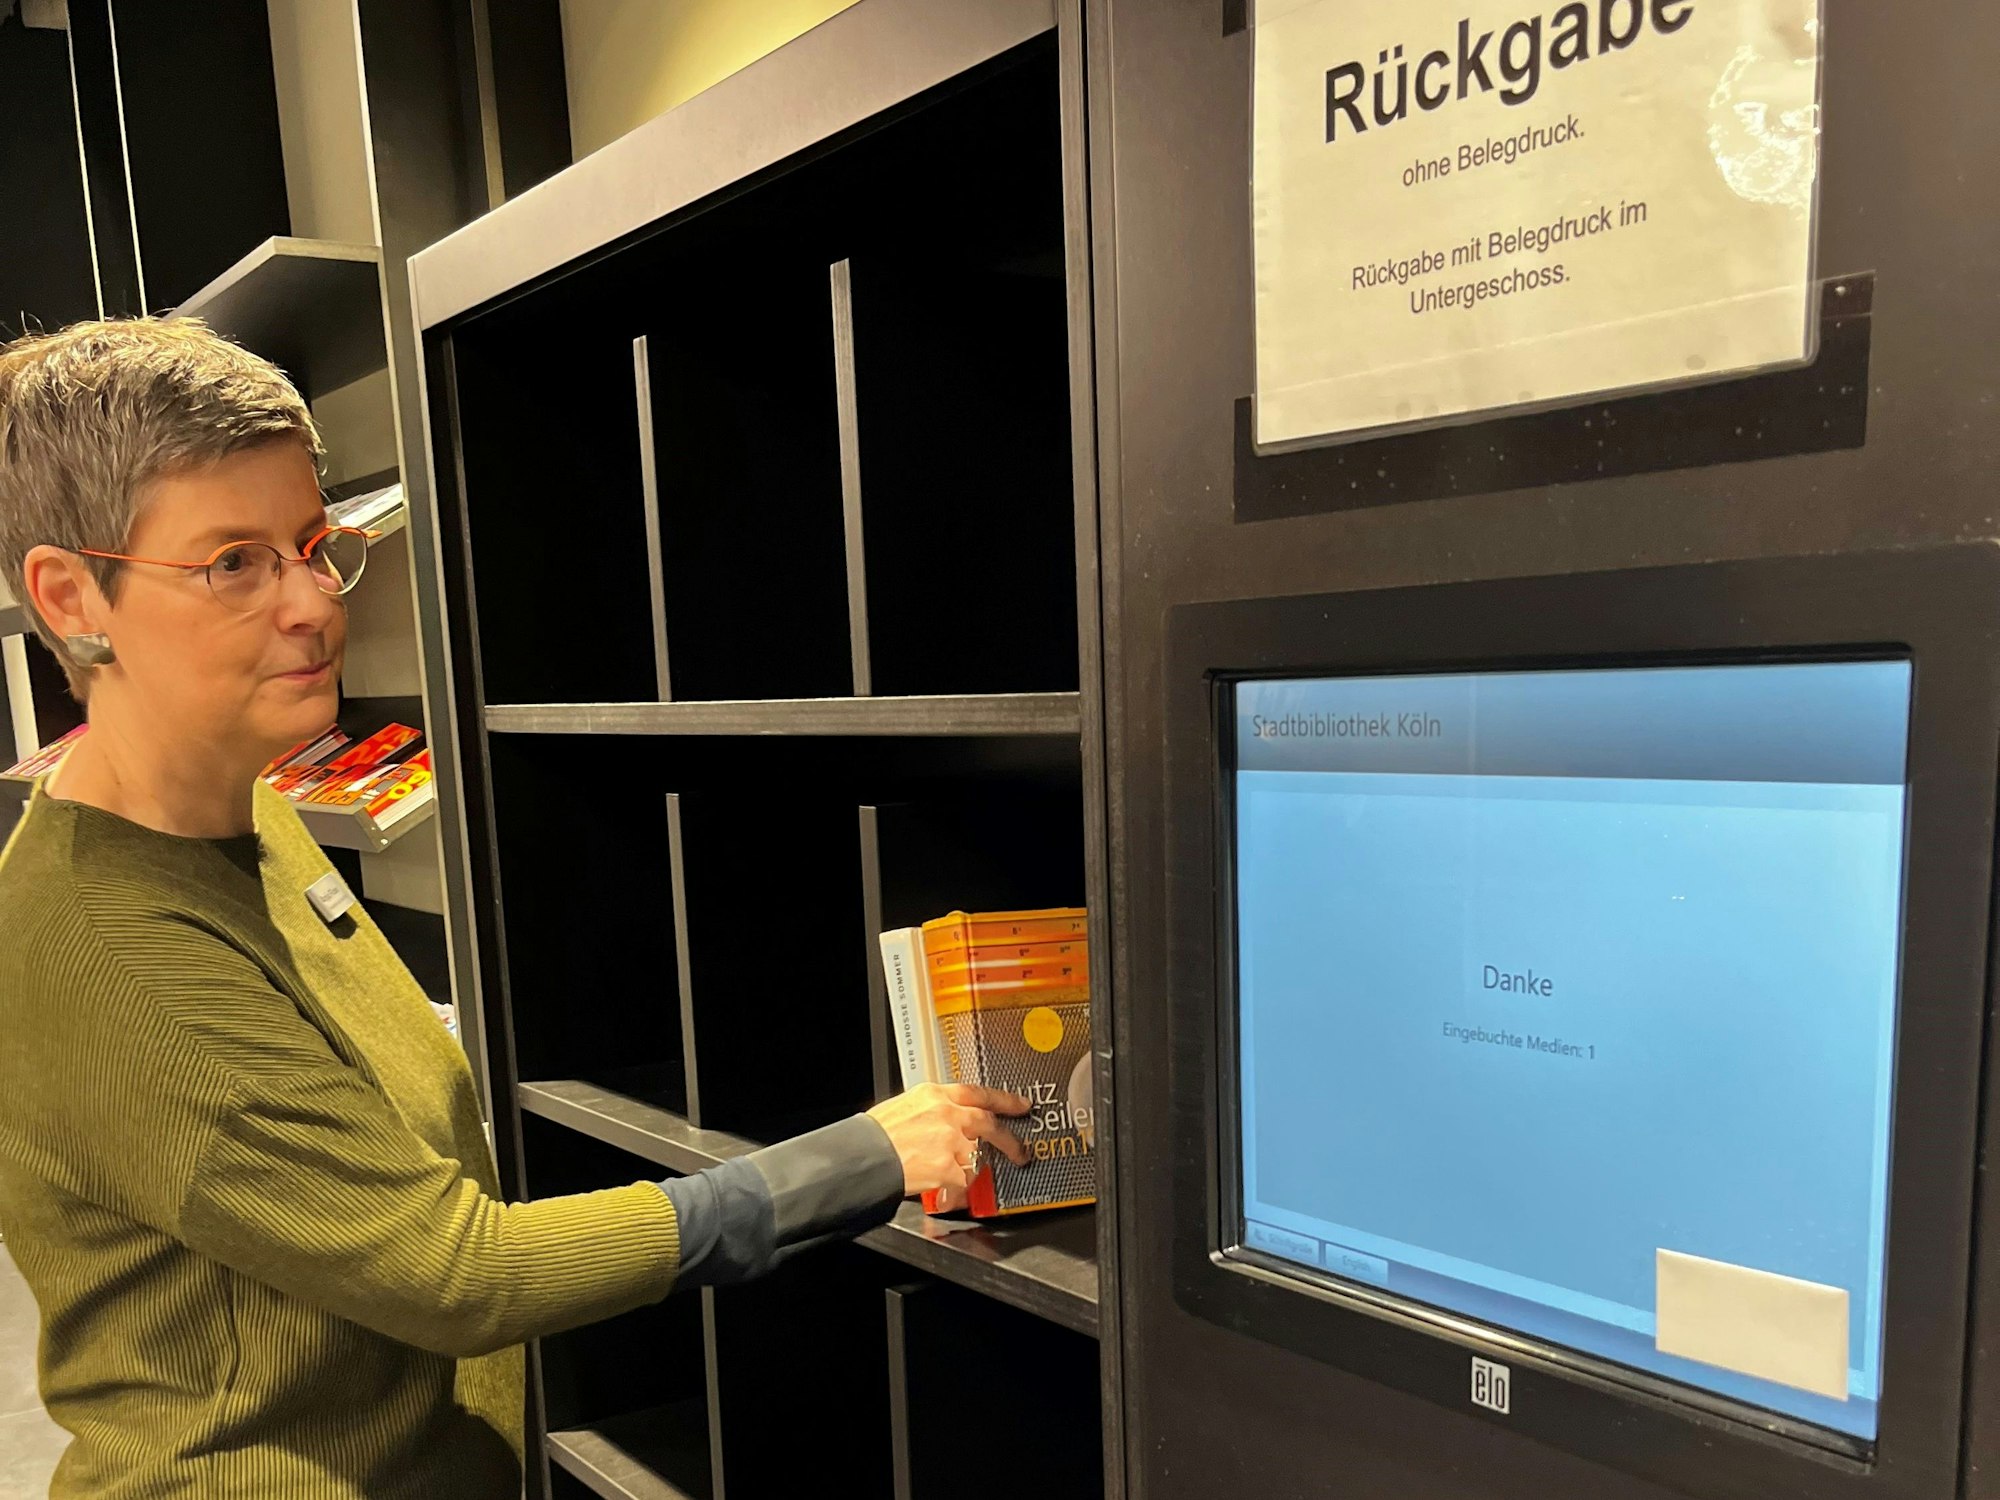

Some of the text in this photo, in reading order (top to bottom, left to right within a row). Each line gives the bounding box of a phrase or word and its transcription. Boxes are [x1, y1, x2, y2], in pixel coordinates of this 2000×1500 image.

[1325, 0, 1694, 144] Rückgabe
[1402, 114, 1585, 187] ohne Belegdruck.
[1352, 200, 1648, 290] Rückgabe mit Belegdruck im
[1410, 263, 1571, 314] Untergeschoss.
[1252, 711, 1442, 738] Stadtbibliothek Köln
[1483, 964, 1554, 997] Danke
[893, 954, 917, 1071] DER GROSSE SOMMER
[1442, 1021, 1523, 1048] Eingebuchte
[1588, 1044, 1596, 1060] 1
